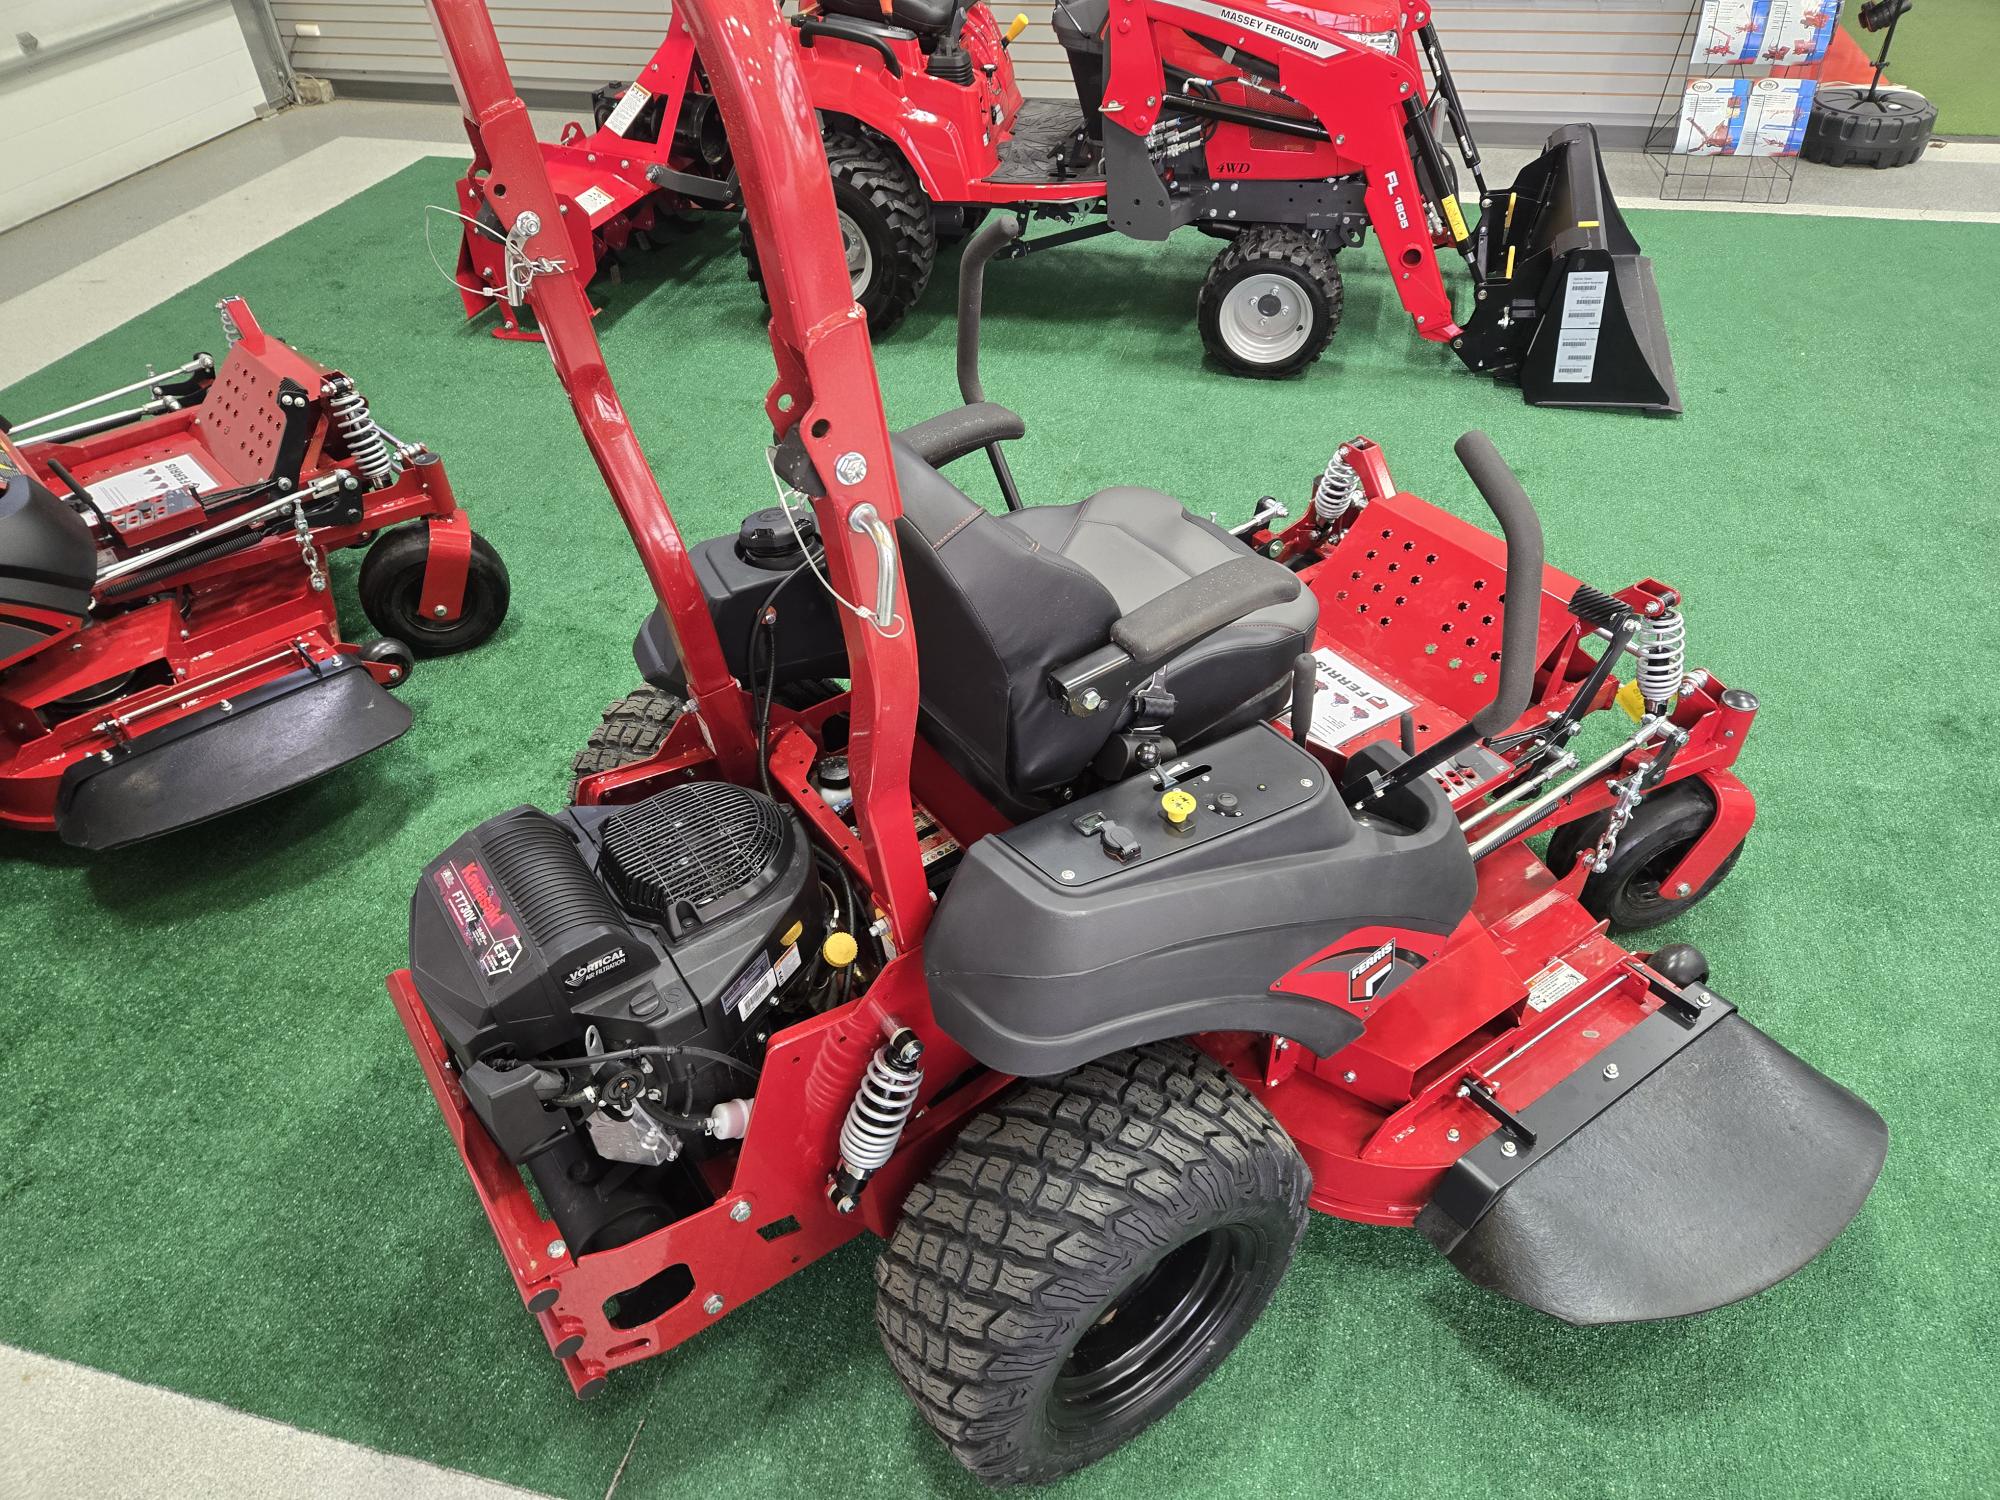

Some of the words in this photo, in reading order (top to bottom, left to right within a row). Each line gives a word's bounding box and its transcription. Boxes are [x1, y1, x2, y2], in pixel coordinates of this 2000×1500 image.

[1220, 9, 1264, 29] MASSEY
[1265, 24, 1320, 51] FERGUSON
[1216, 162, 1250, 173] 4WD
[1384, 171, 1399, 195] FL
[165, 463, 192, 485] FERRIS
[1316, 661, 1370, 697] FERRIS
[451, 890, 477, 922] FT730V
[461, 861, 505, 927] Kawasaki
[494, 942, 512, 966] EFI
[570, 949, 626, 981] VORTICAL
[585, 972, 596, 981] AIR
[595, 957, 626, 976] FILTRATION
[1351, 942, 1393, 980] FERRIS
